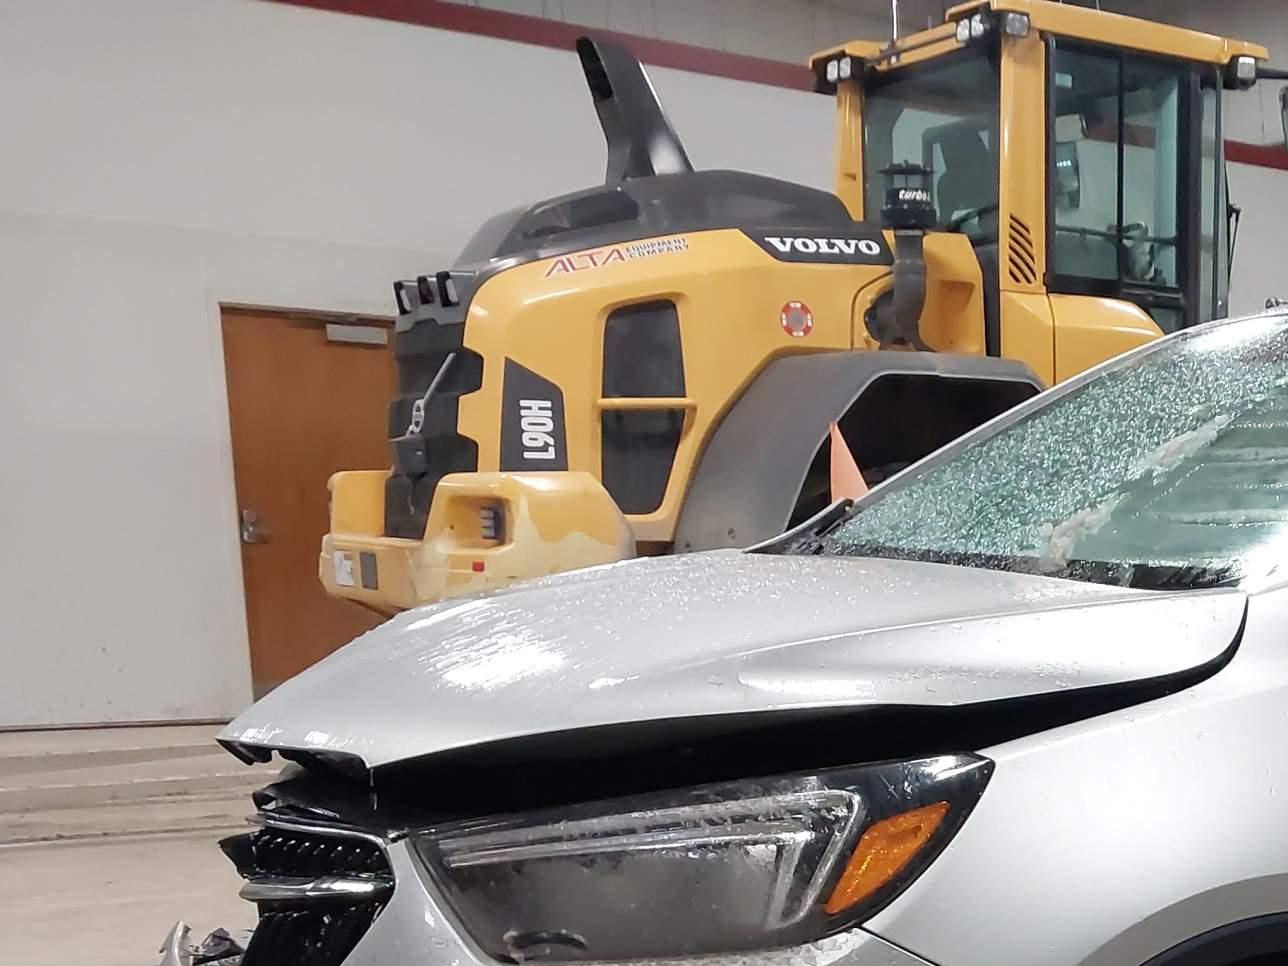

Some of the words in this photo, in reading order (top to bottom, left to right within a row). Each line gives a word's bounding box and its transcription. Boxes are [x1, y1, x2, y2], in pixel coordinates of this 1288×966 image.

[625, 237, 687, 253] EQUIPMENT
[629, 244, 689, 258] COMPANY
[764, 237, 881, 255] VOLVO
[545, 248, 626, 278] ALTA
[519, 399, 556, 460] L90H
